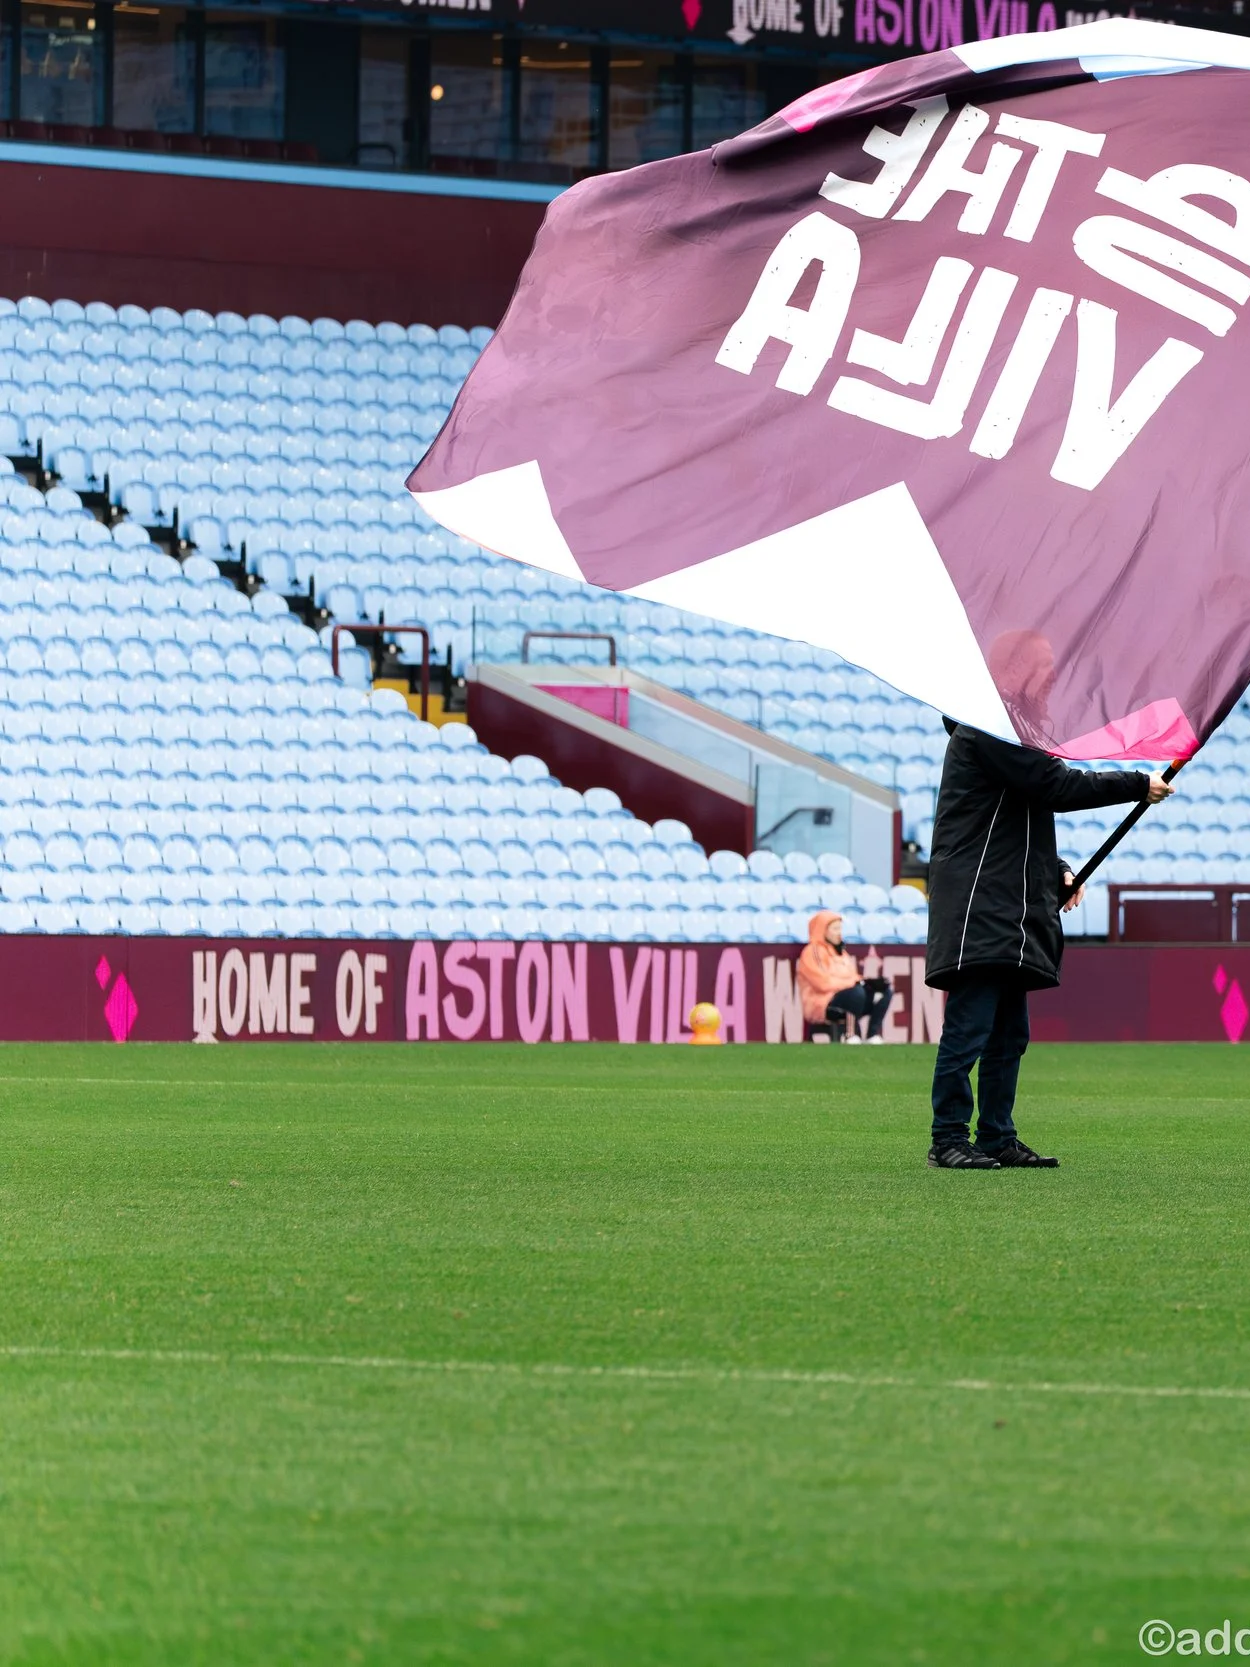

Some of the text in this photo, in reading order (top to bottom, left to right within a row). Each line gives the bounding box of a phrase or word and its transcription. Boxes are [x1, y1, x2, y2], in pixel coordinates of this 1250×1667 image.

[814, 0, 843, 37] OF
[855, 0, 963, 50] ASTON
[193, 948, 316, 1042] HOME
[336, 949, 387, 1036] OF
[405, 940, 589, 1043] ASTON
[609, 947, 747, 1043] VILLA
